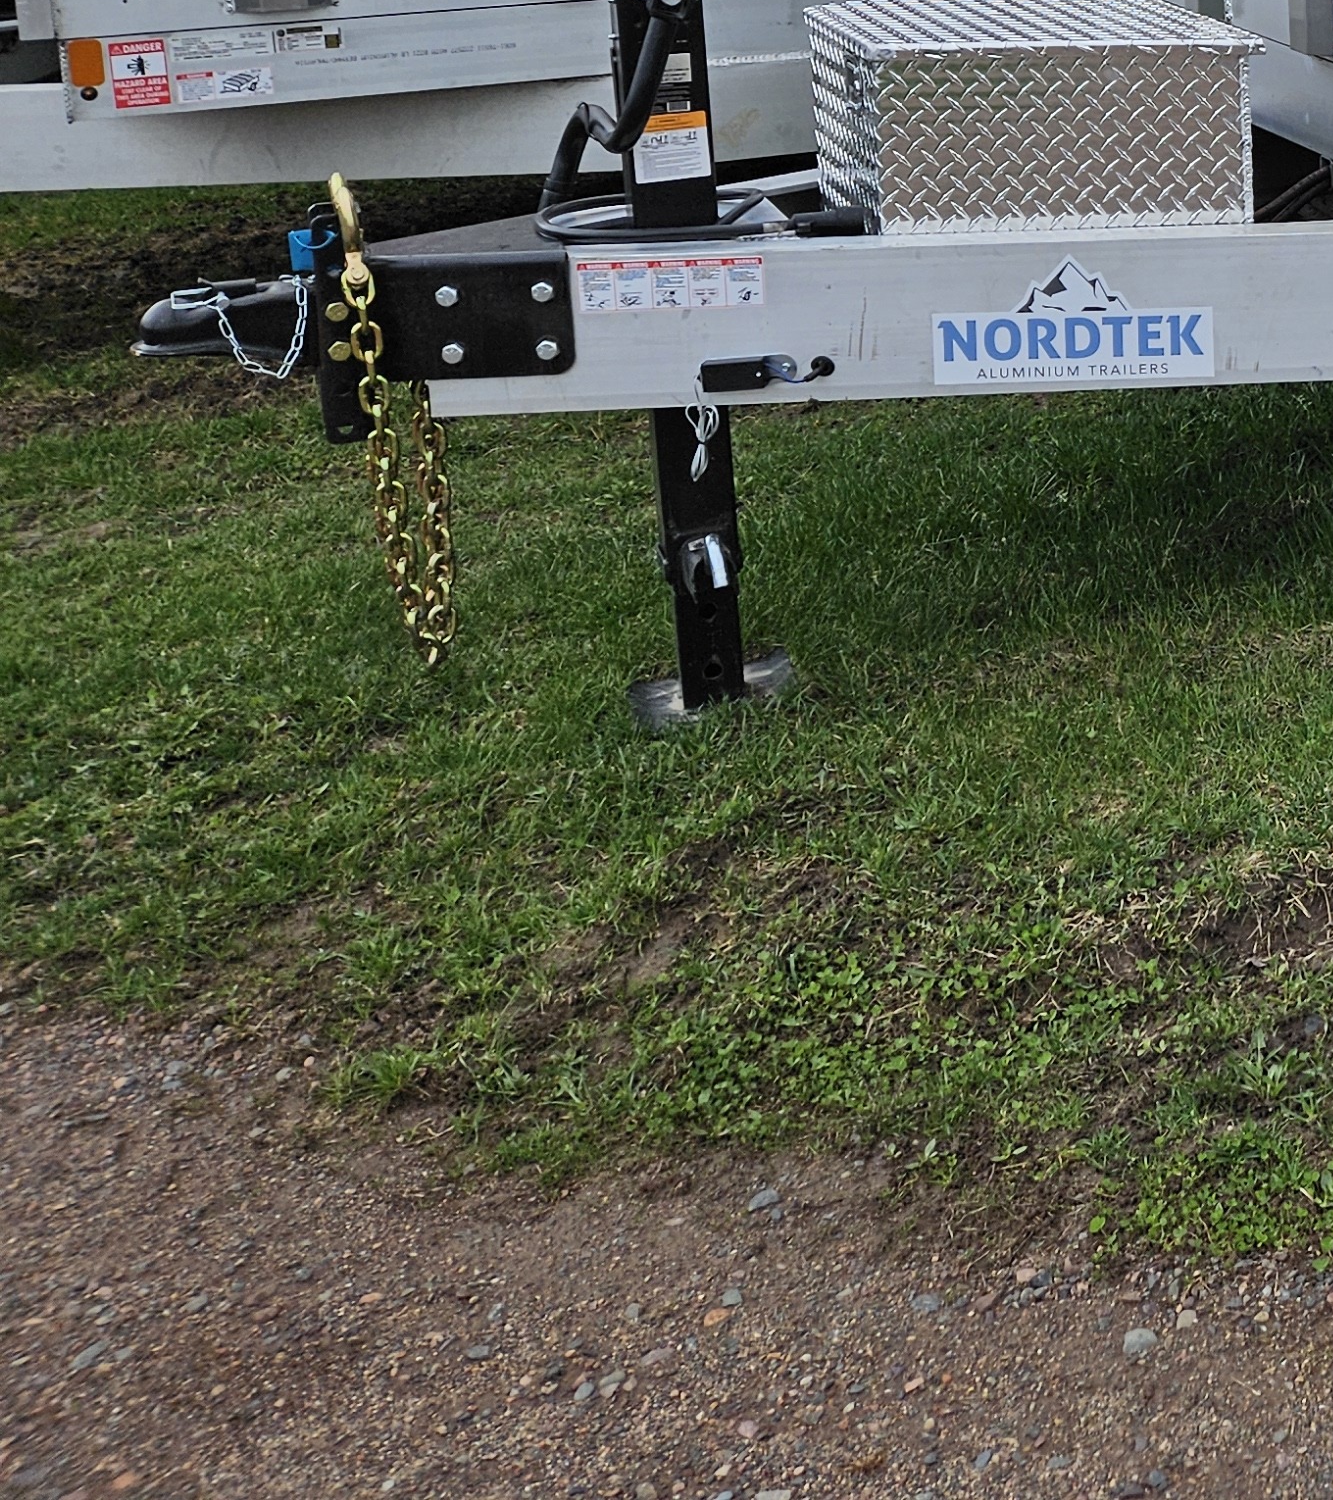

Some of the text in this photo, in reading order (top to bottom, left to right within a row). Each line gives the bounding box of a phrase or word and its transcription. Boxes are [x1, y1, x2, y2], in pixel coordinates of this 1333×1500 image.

[122, 41, 162, 54] DANGER
[937, 313, 1204, 362] NORDTEK
[976, 362, 1169, 380] ALUMINIUM TRAILERS
